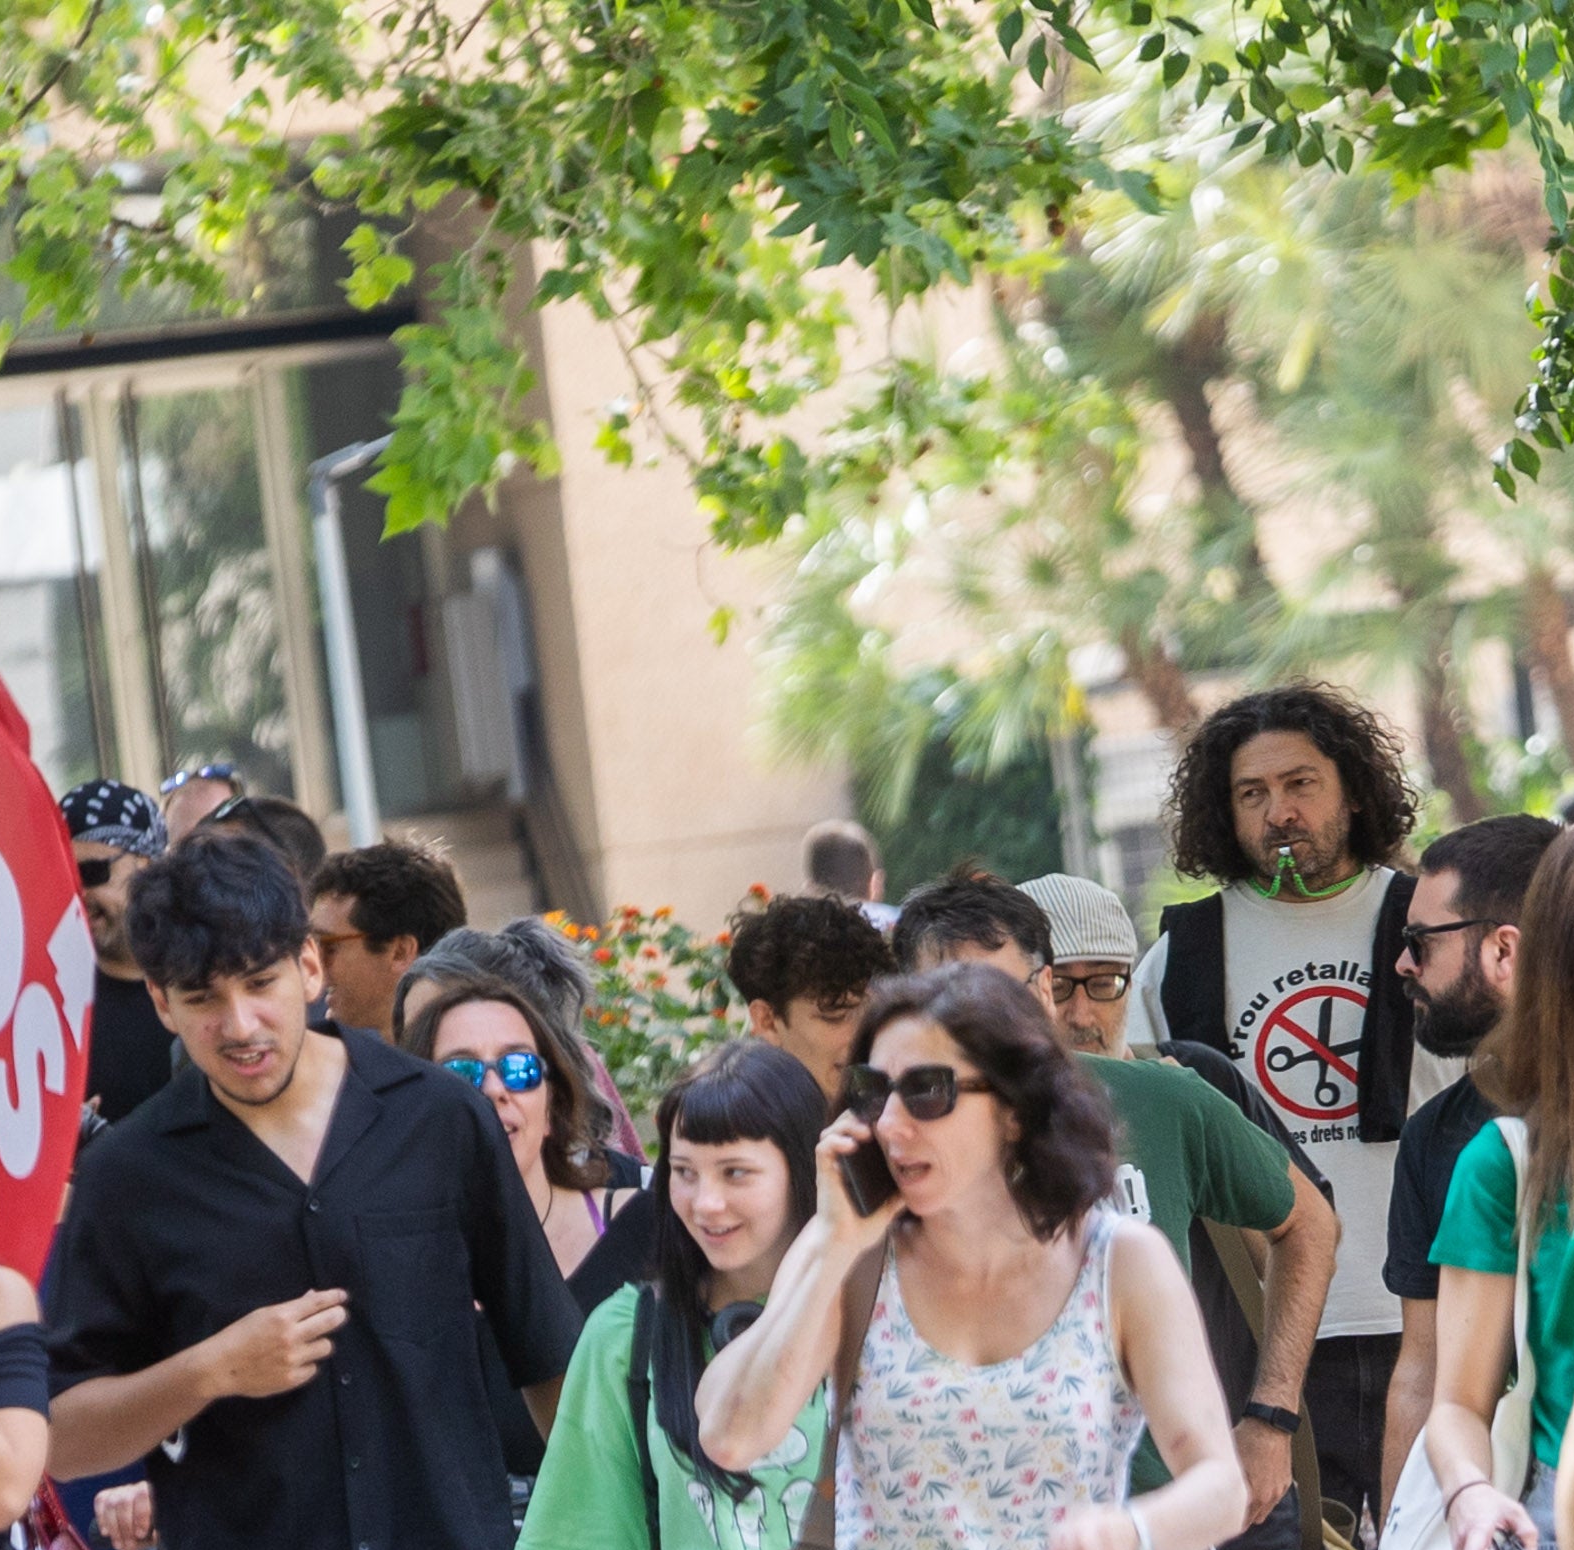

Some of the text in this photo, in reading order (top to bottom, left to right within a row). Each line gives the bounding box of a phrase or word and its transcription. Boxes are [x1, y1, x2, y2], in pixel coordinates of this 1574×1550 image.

[1226, 960, 1374, 1061] Prou retalla
[1310, 1124, 1344, 1143] drets
